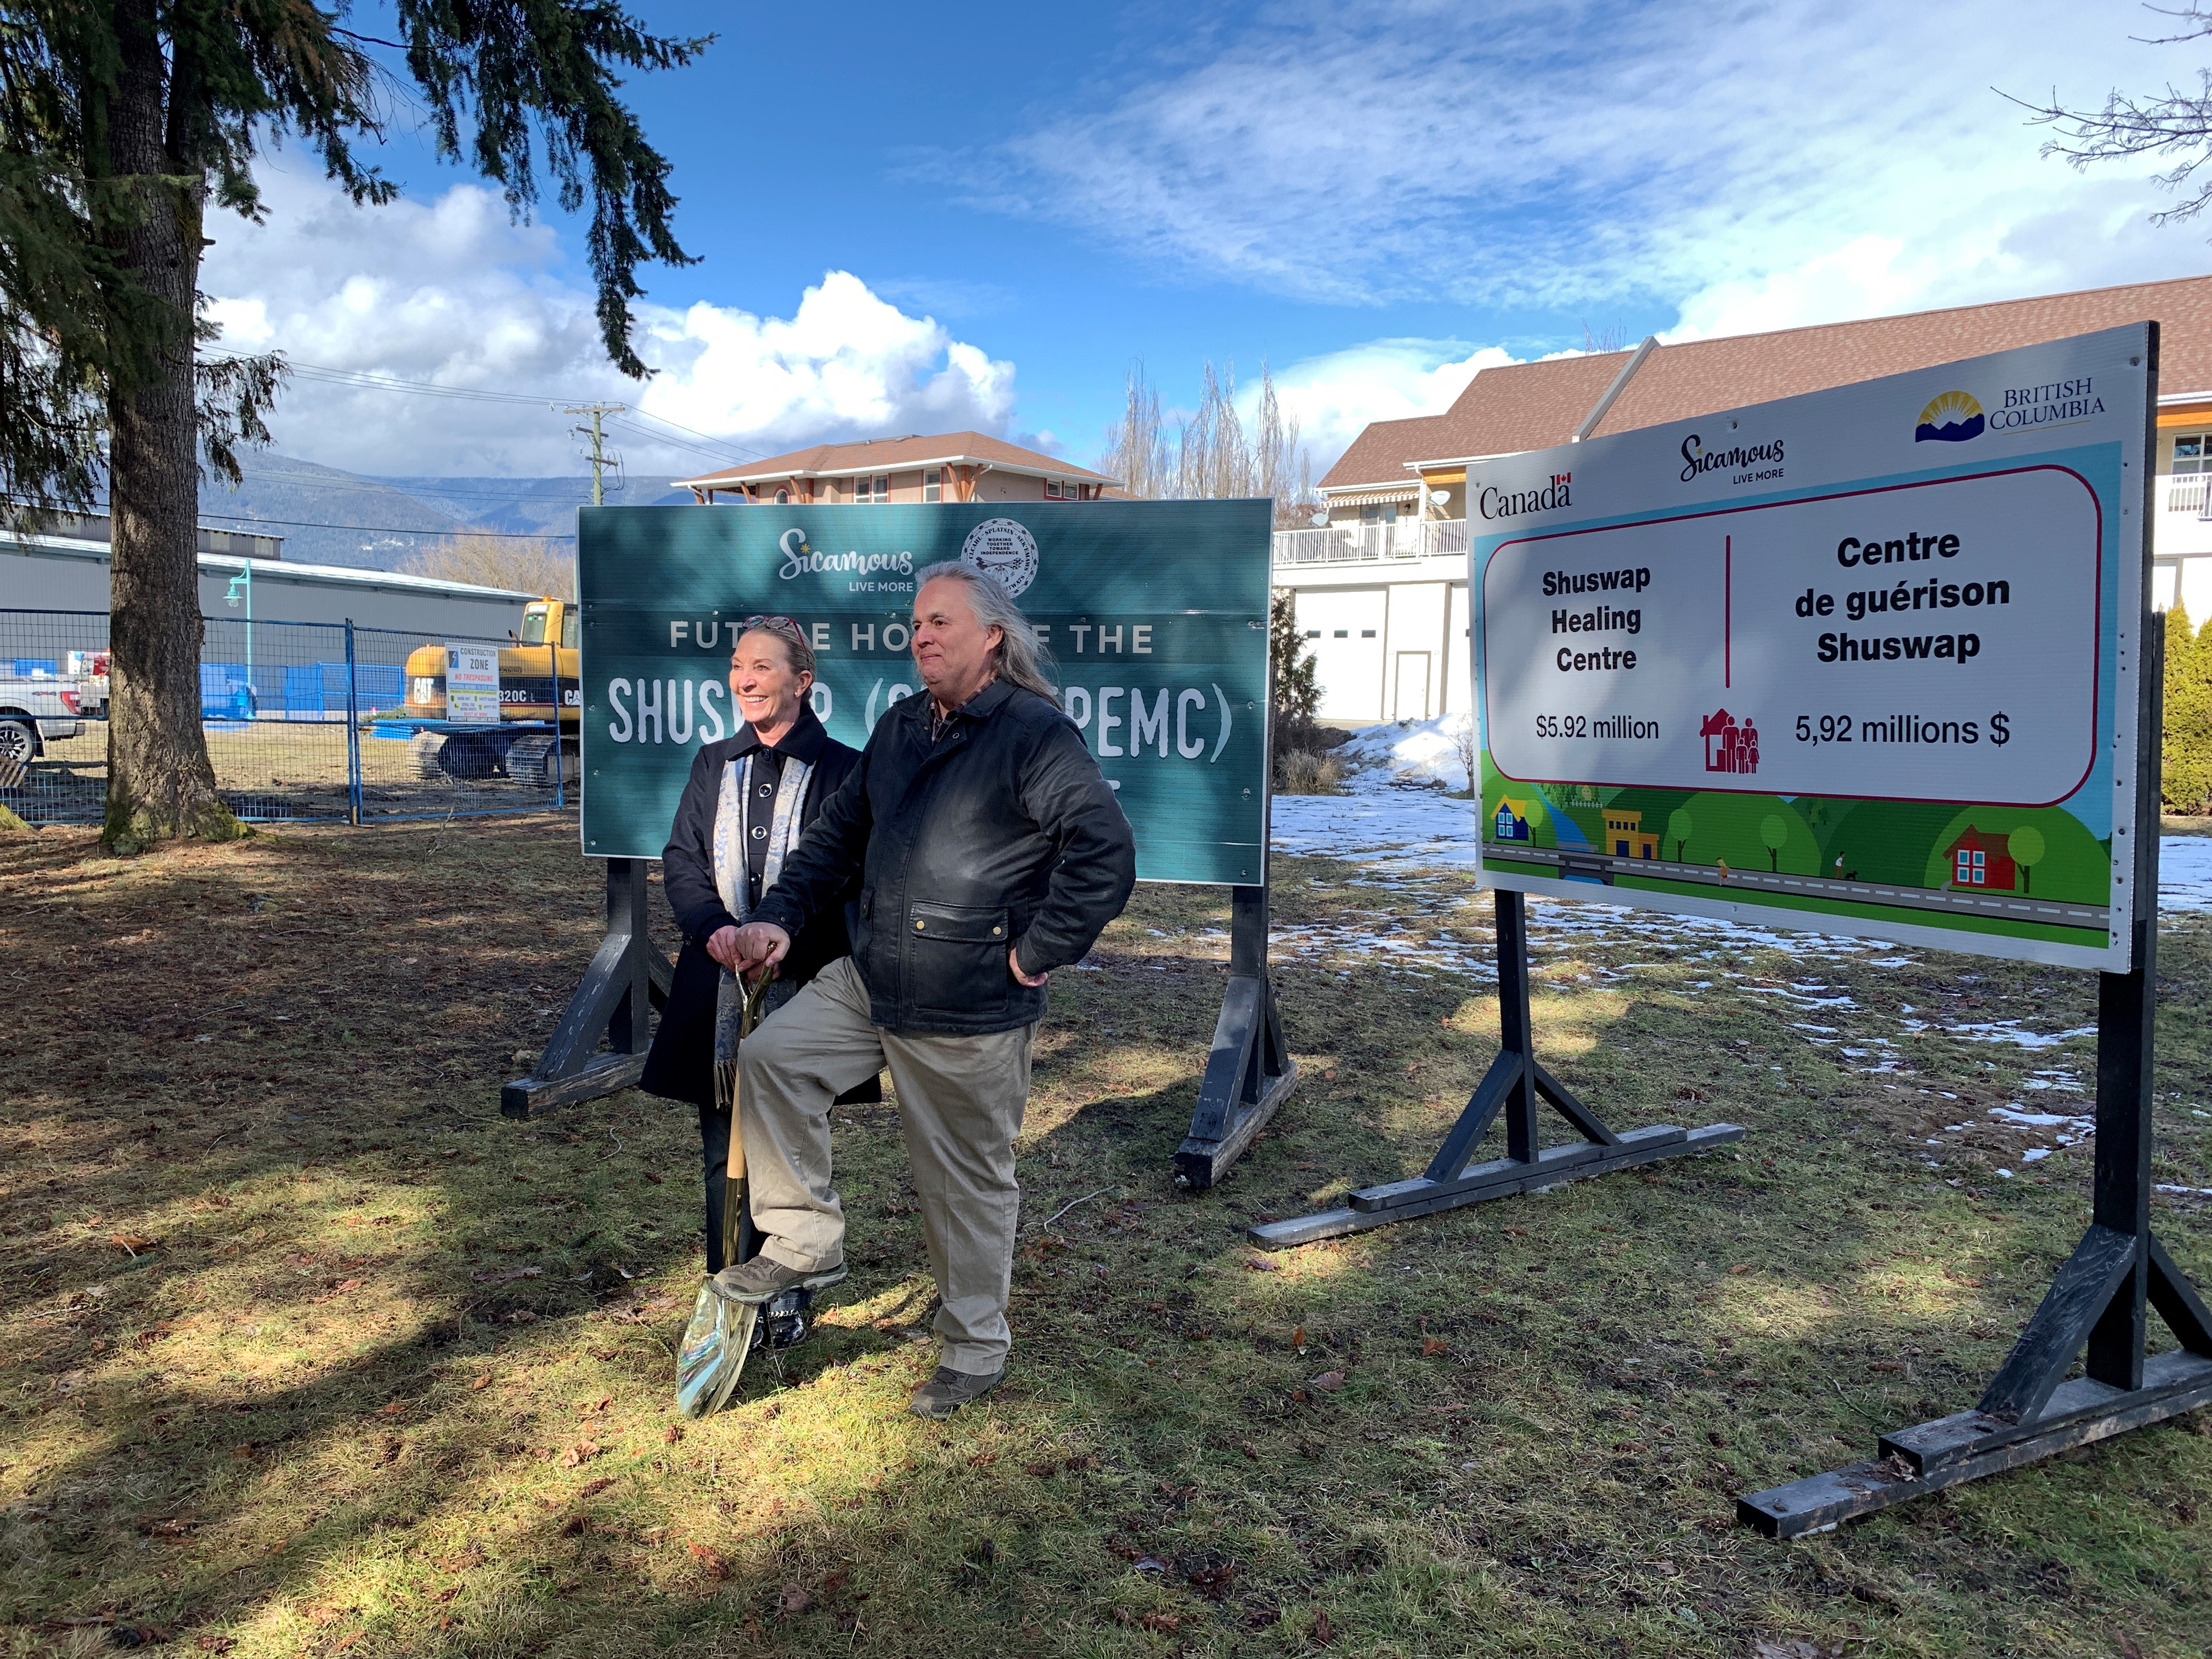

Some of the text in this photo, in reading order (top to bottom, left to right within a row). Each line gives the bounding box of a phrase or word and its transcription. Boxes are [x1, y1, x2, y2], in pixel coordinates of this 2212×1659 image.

[2004, 377, 2093, 408] BRITISH
[1990, 397, 2106, 430] COLUMBIA
[1680, 434, 1785, 482] Sicamous
[1733, 469, 1785, 485] LIVE MORE
[1480, 475, 1572, 520] Canada
[985, 527, 1014, 535] SPLATSIN
[779, 528, 913, 580] Sicamous
[1837, 532, 1960, 567] Centre
[849, 582, 913, 592] LIVE MORE
[1542, 567, 1651, 596] Shuswap
[1795, 578, 2010, 620] de guérison
[1552, 605, 1641, 634] Healing
[670, 621, 831, 651] FUTE
[1069, 625, 1152, 653] THE
[1817, 633, 1980, 664] Shuswap
[460, 647, 496, 657] CONSTRUCTION
[470, 659, 489, 670] ZONE
[1557, 647, 1637, 672] Centre
[414, 677, 434, 704] CAT
[464, 674, 493, 682] TRESPASSING
[499, 690, 527, 702] 320C
[1536, 713, 1659, 740] $5.92 million
[1795, 711, 2010, 747] 5,92 millions $
